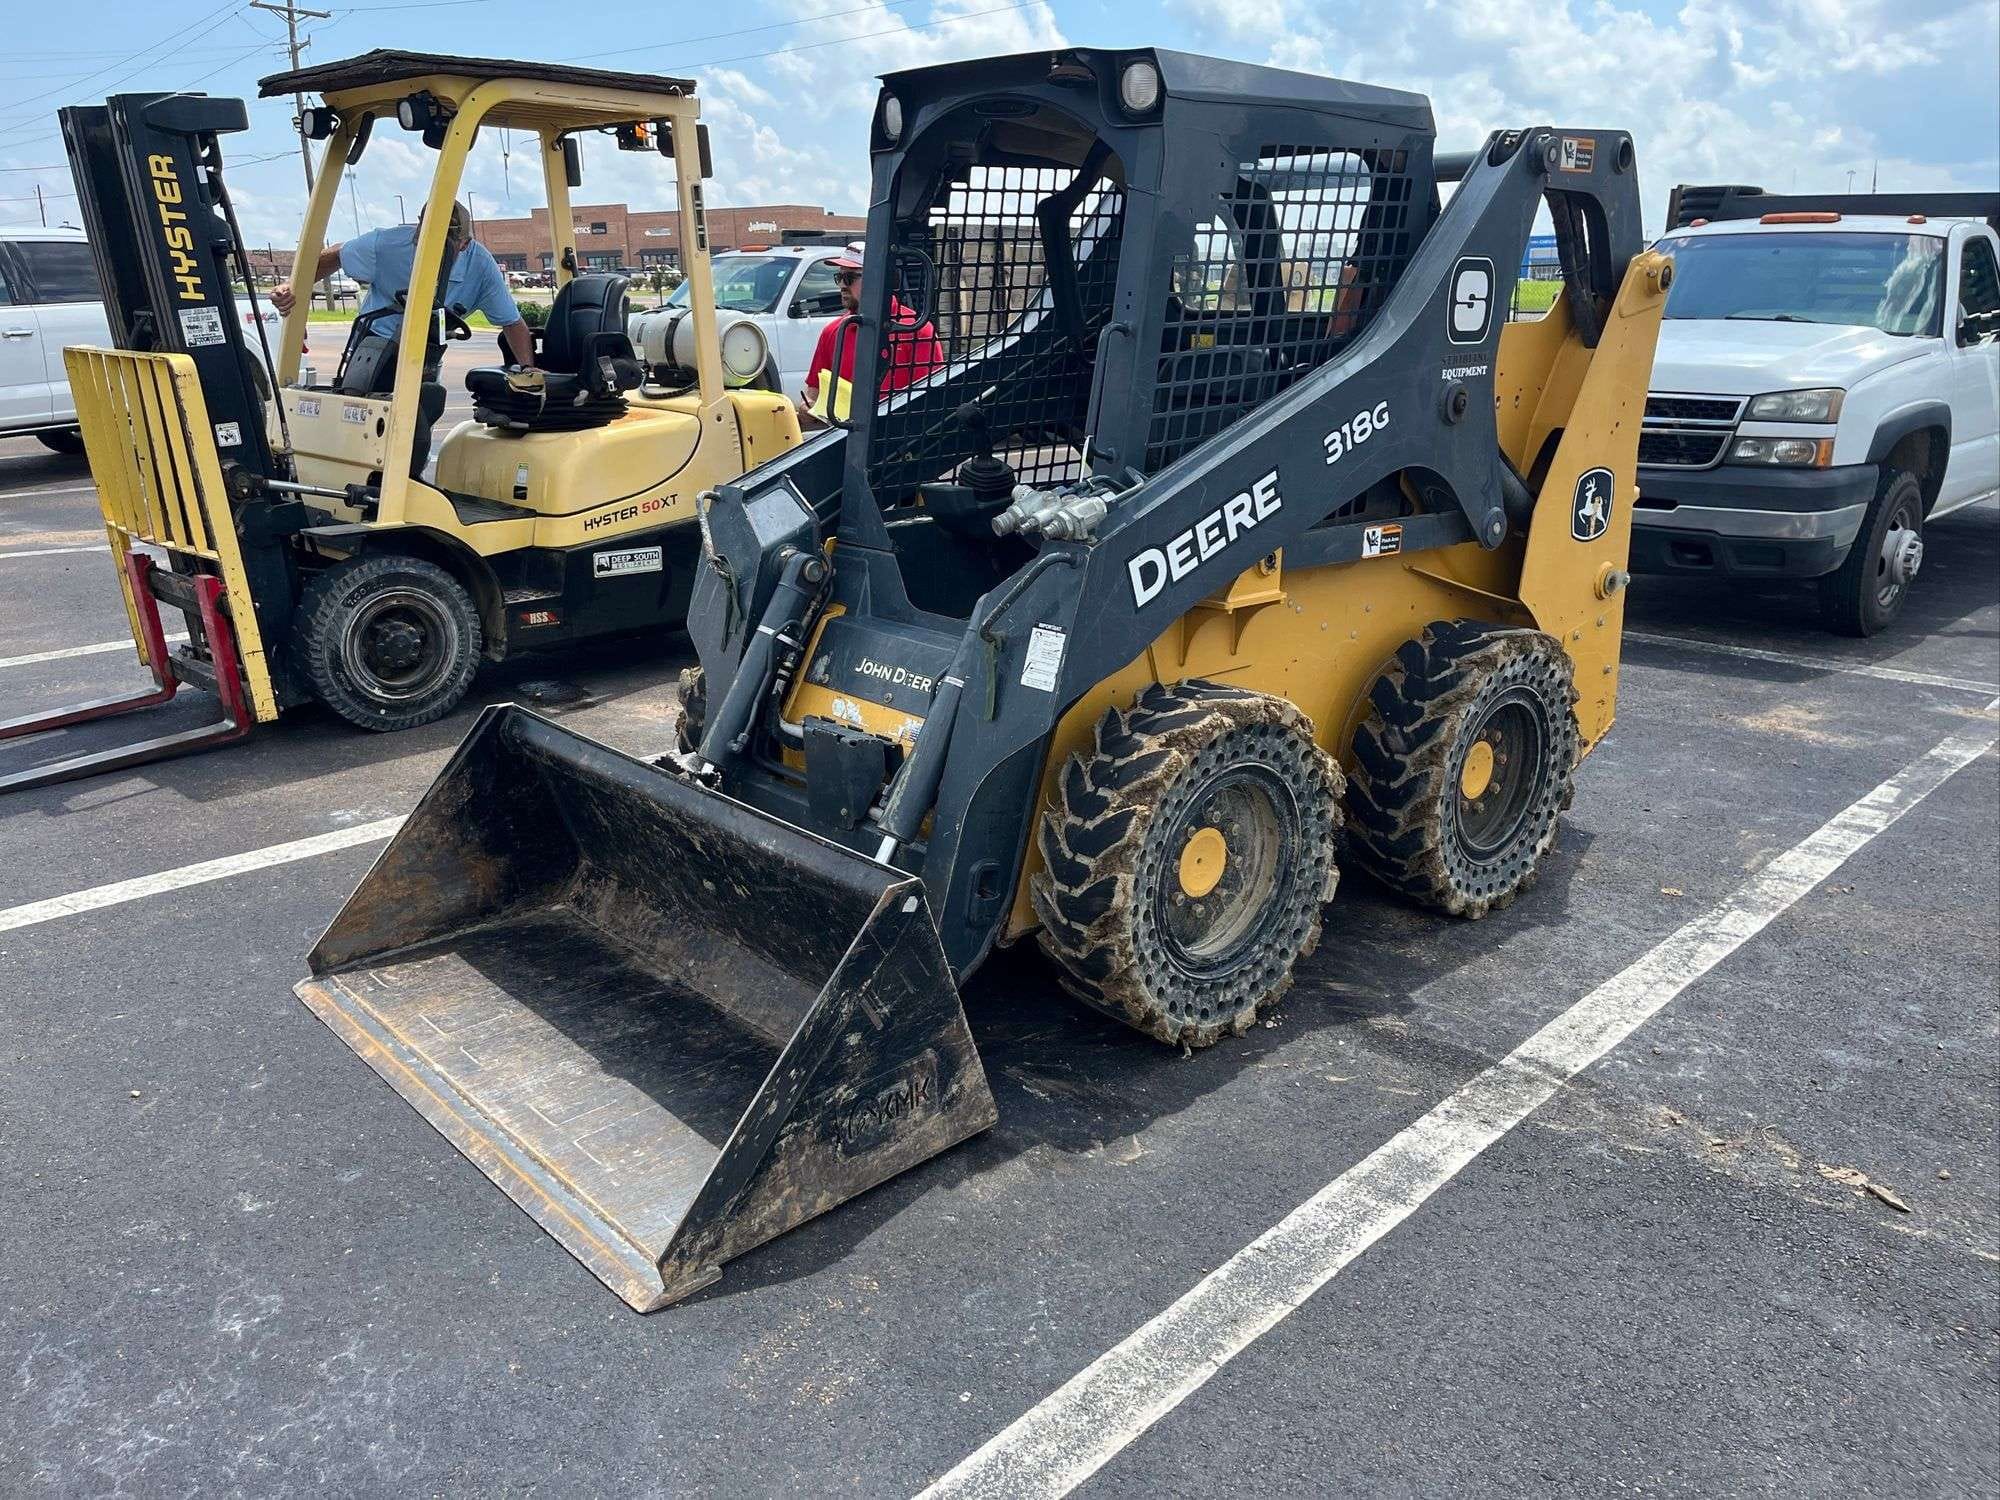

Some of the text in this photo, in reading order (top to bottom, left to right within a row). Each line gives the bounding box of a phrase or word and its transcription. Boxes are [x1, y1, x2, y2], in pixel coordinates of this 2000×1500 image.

[149, 154, 205, 300] HYSTER
[1454, 270, 1489, 331] S
[1441, 366, 1488, 380] EQUIPMENT
[1323, 401, 1390, 465] 318G
[584, 494, 678, 531] HYSTER 50XT
[611, 552, 659, 564] DEEP SOUTH
[1128, 470, 1282, 608] DEERE
[855, 658, 941, 695] JOHN DEER
